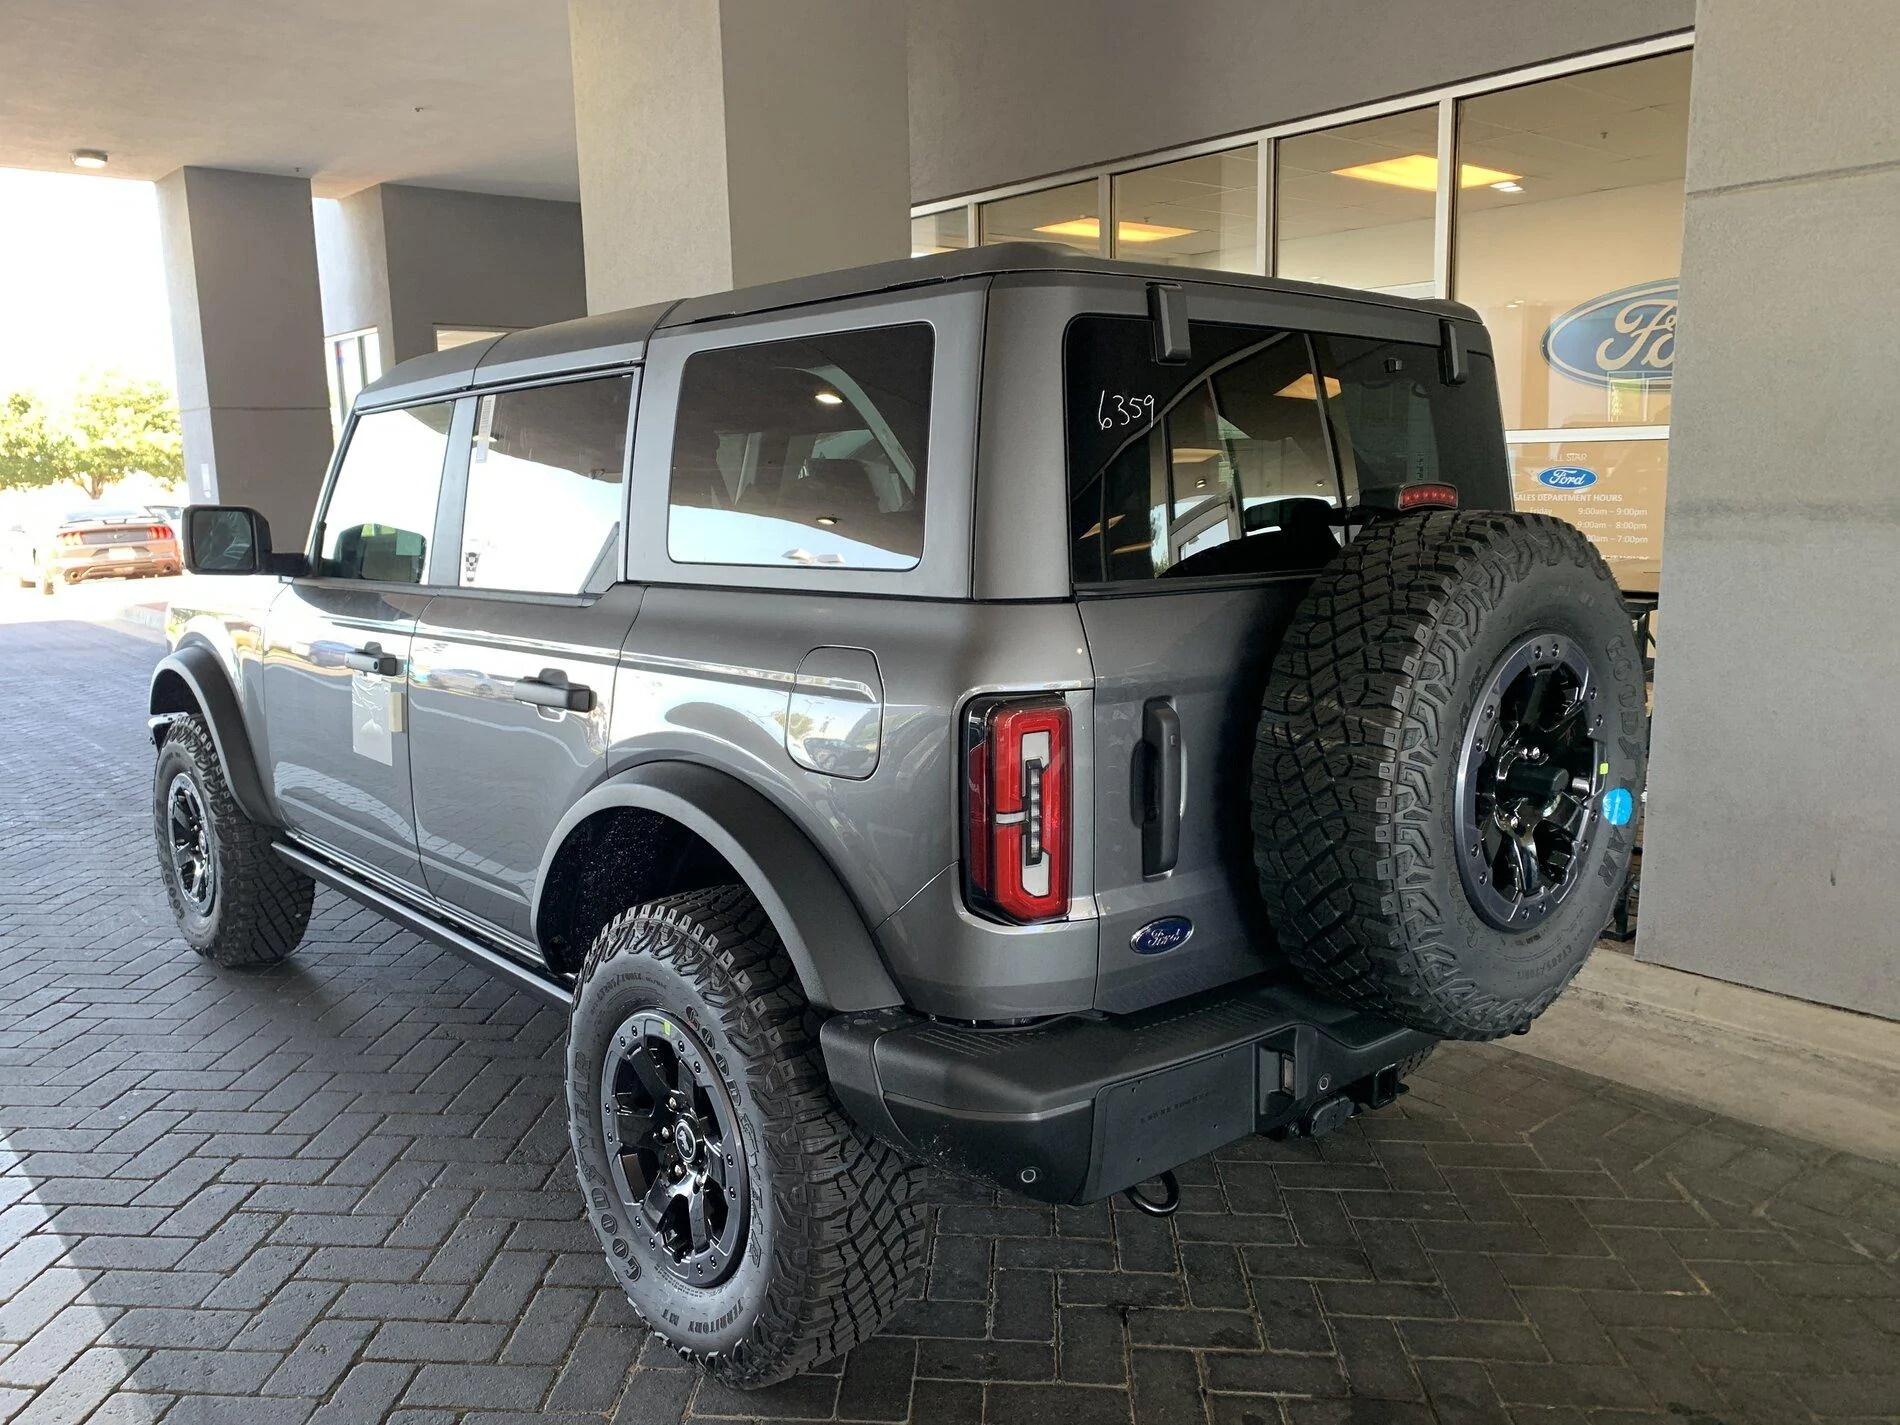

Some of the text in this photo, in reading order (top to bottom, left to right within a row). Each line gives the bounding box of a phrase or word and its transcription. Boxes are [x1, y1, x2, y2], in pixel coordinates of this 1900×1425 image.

[1596, 299, 1678, 371] Fo
[1098, 389, 1155, 430] 6359
[1566, 453, 1588, 462] STAR
[1549, 469, 1585, 485] Ford
[1538, 494, 1592, 502] DEPARTMENT
[1593, 494, 1623, 502] HOURS
[1578, 507, 1608, 516] 9:00am
[1616, 507, 1648, 517] 9:00pm
[1577, 521, 1607, 530] 9:00am
[1615, 521, 1648, 531] 8:00pm
[1616, 535, 1649, 545] 7:00pm
[572, 1050, 642, 1283] GOODYEAR
[661, 1298, 744, 1335] TERRITORY MT
